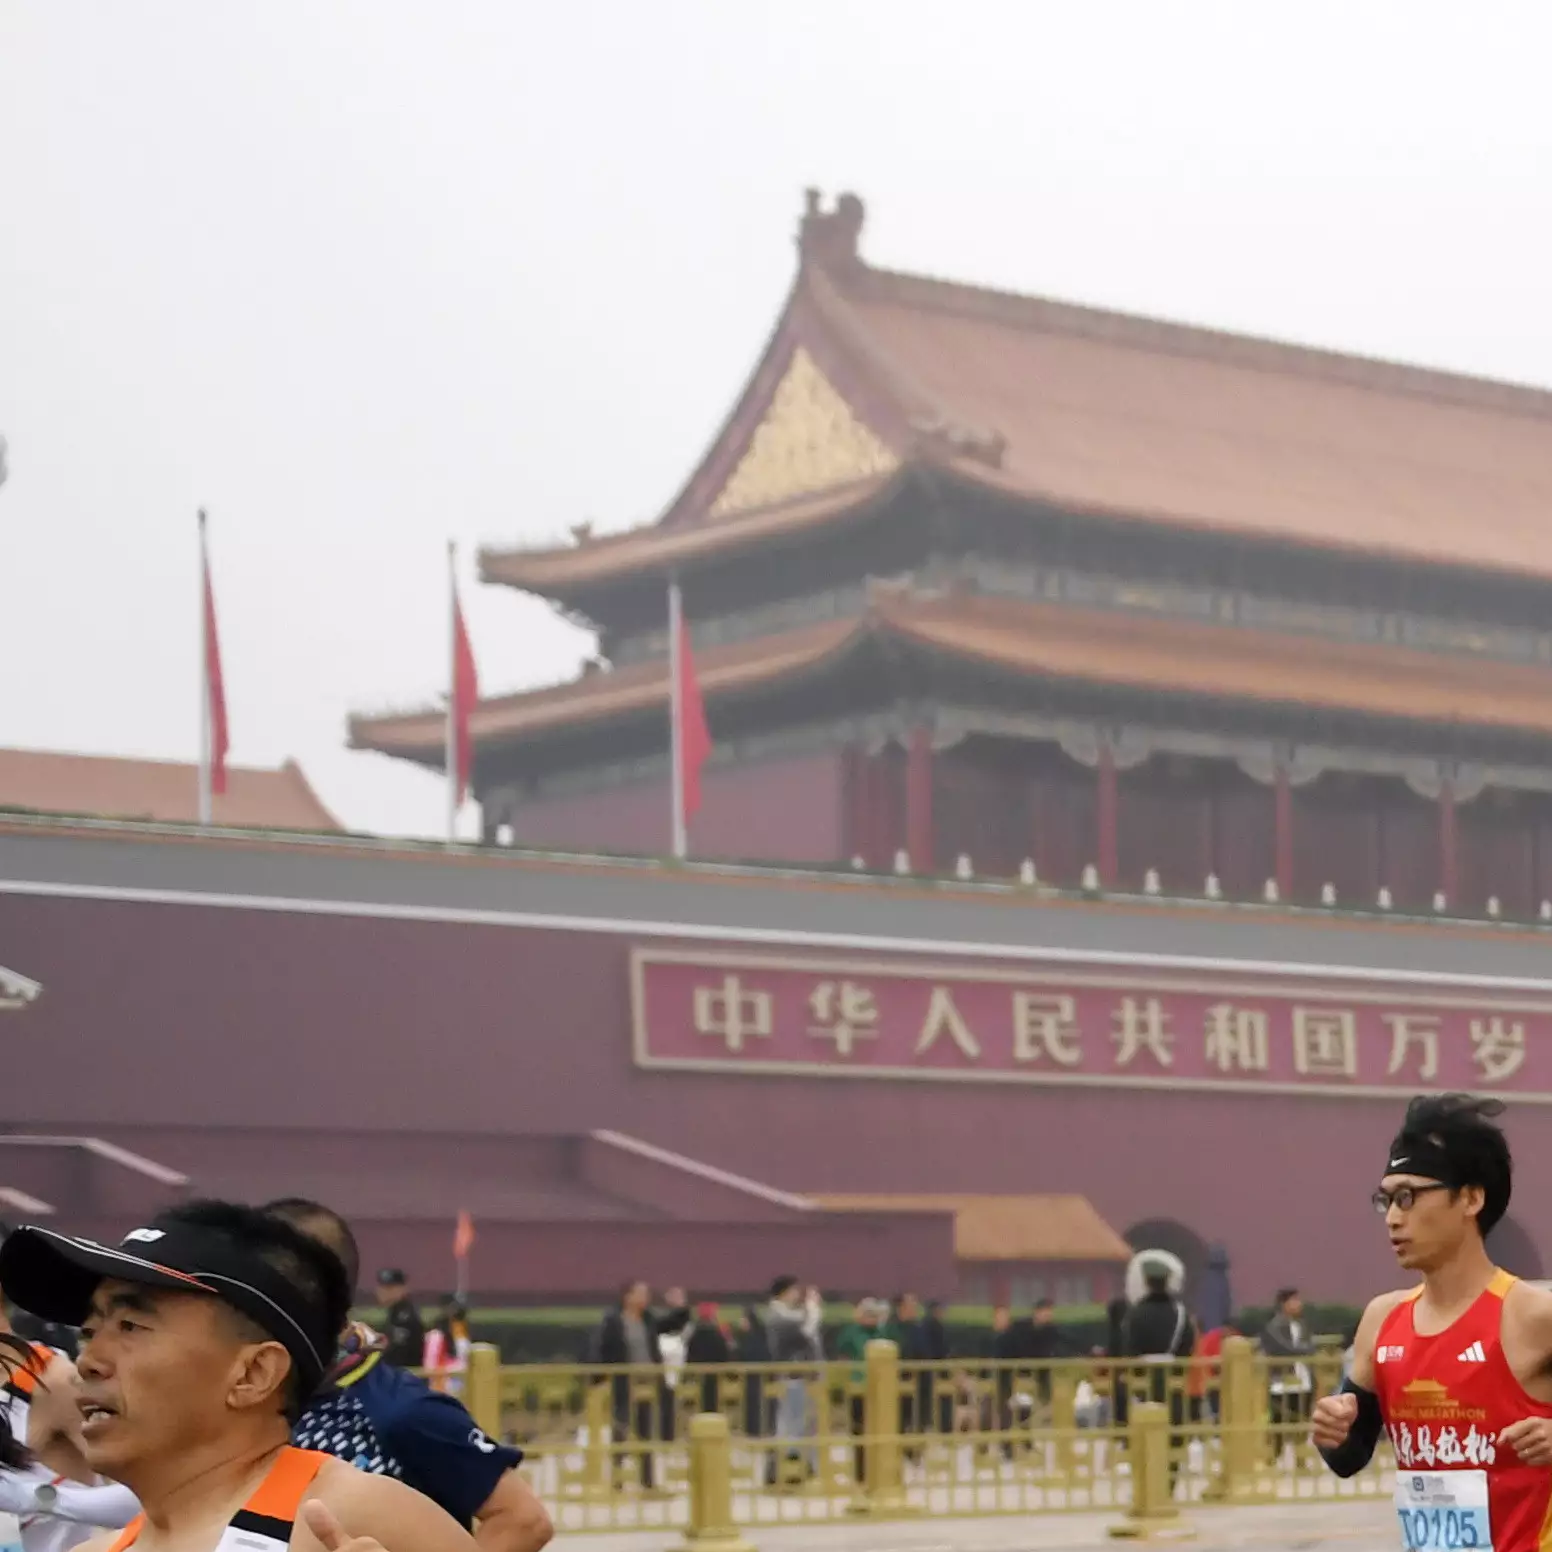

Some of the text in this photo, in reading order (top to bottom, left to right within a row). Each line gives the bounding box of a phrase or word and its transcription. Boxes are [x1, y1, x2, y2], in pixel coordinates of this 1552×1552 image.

[693, 975, 1528, 1085] 中华人民共和国万岁
[1398, 1508, 1478, 1549] T0105
